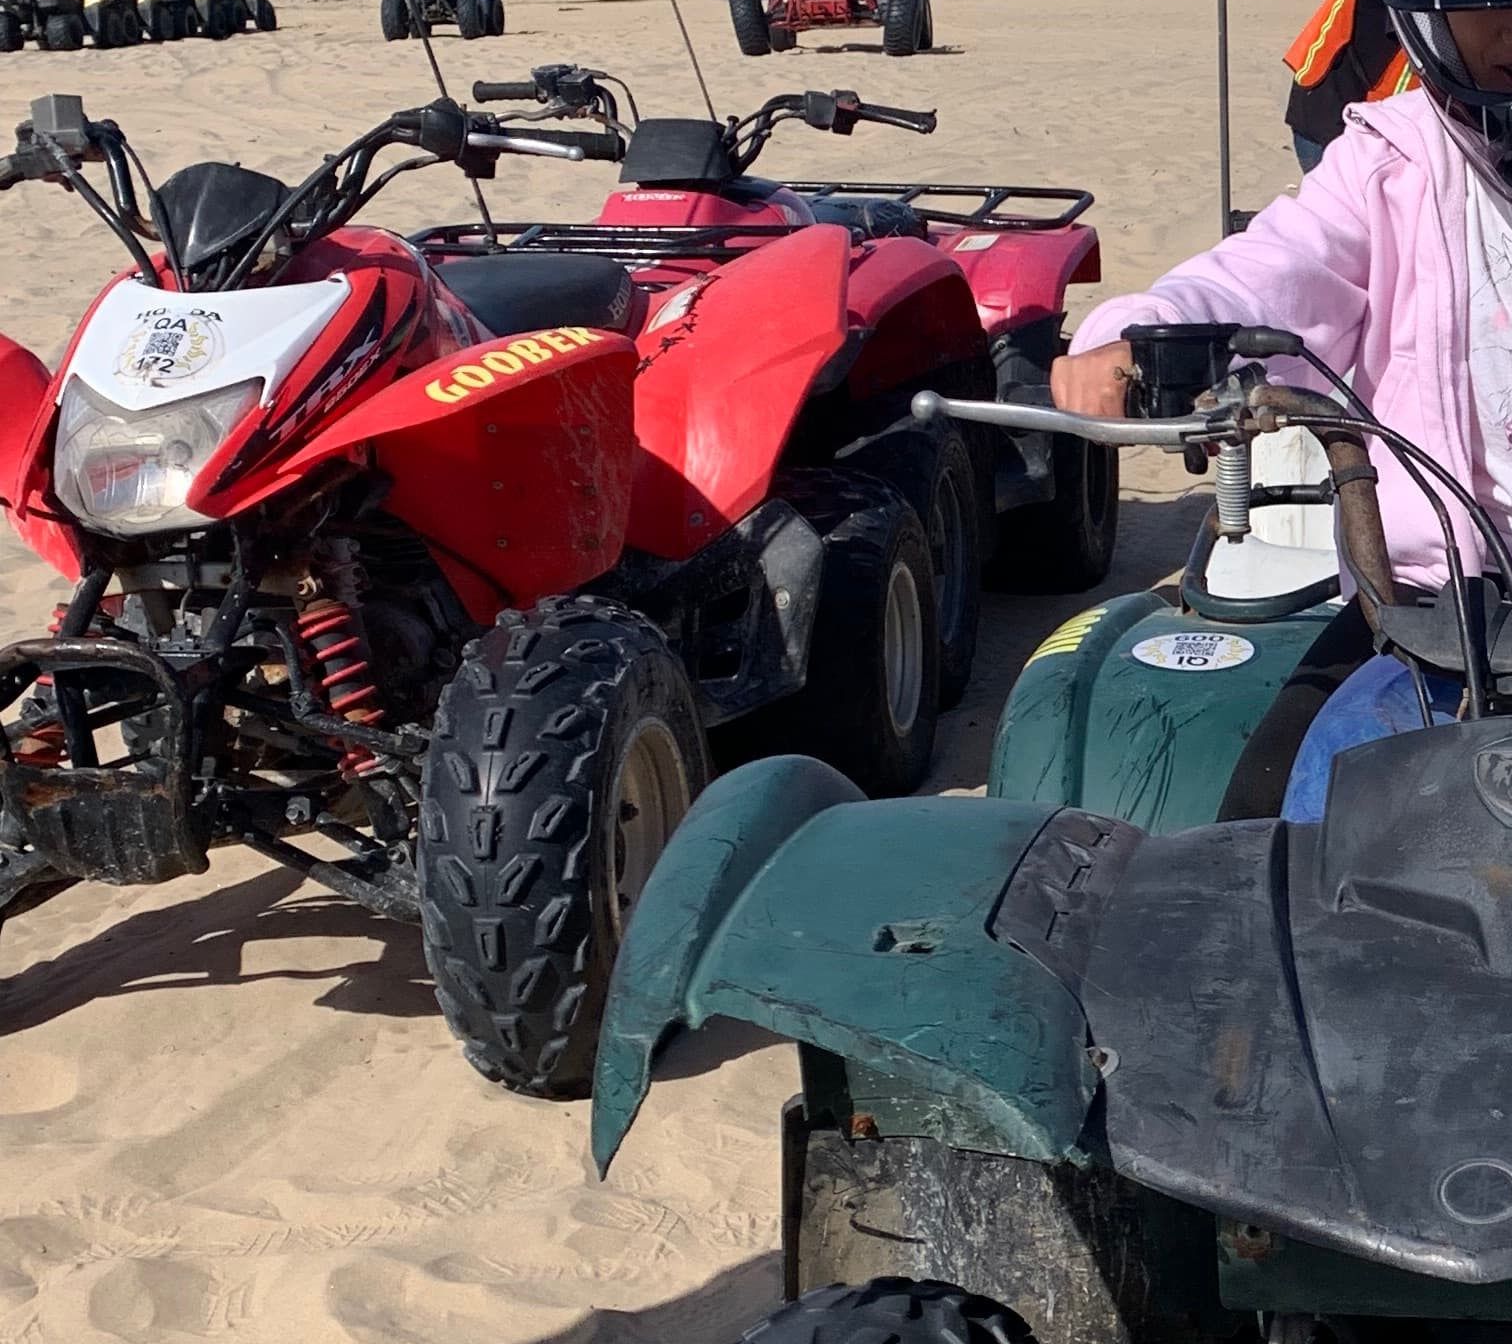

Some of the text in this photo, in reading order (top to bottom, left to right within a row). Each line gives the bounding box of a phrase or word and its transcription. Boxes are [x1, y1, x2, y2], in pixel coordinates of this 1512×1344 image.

[136, 308, 223, 322] HODA
[154, 318, 187, 331] QA
[425, 326, 604, 403] GOOBER
[269, 326, 378, 440] TRX
[1177, 656, 1208, 666] QI
